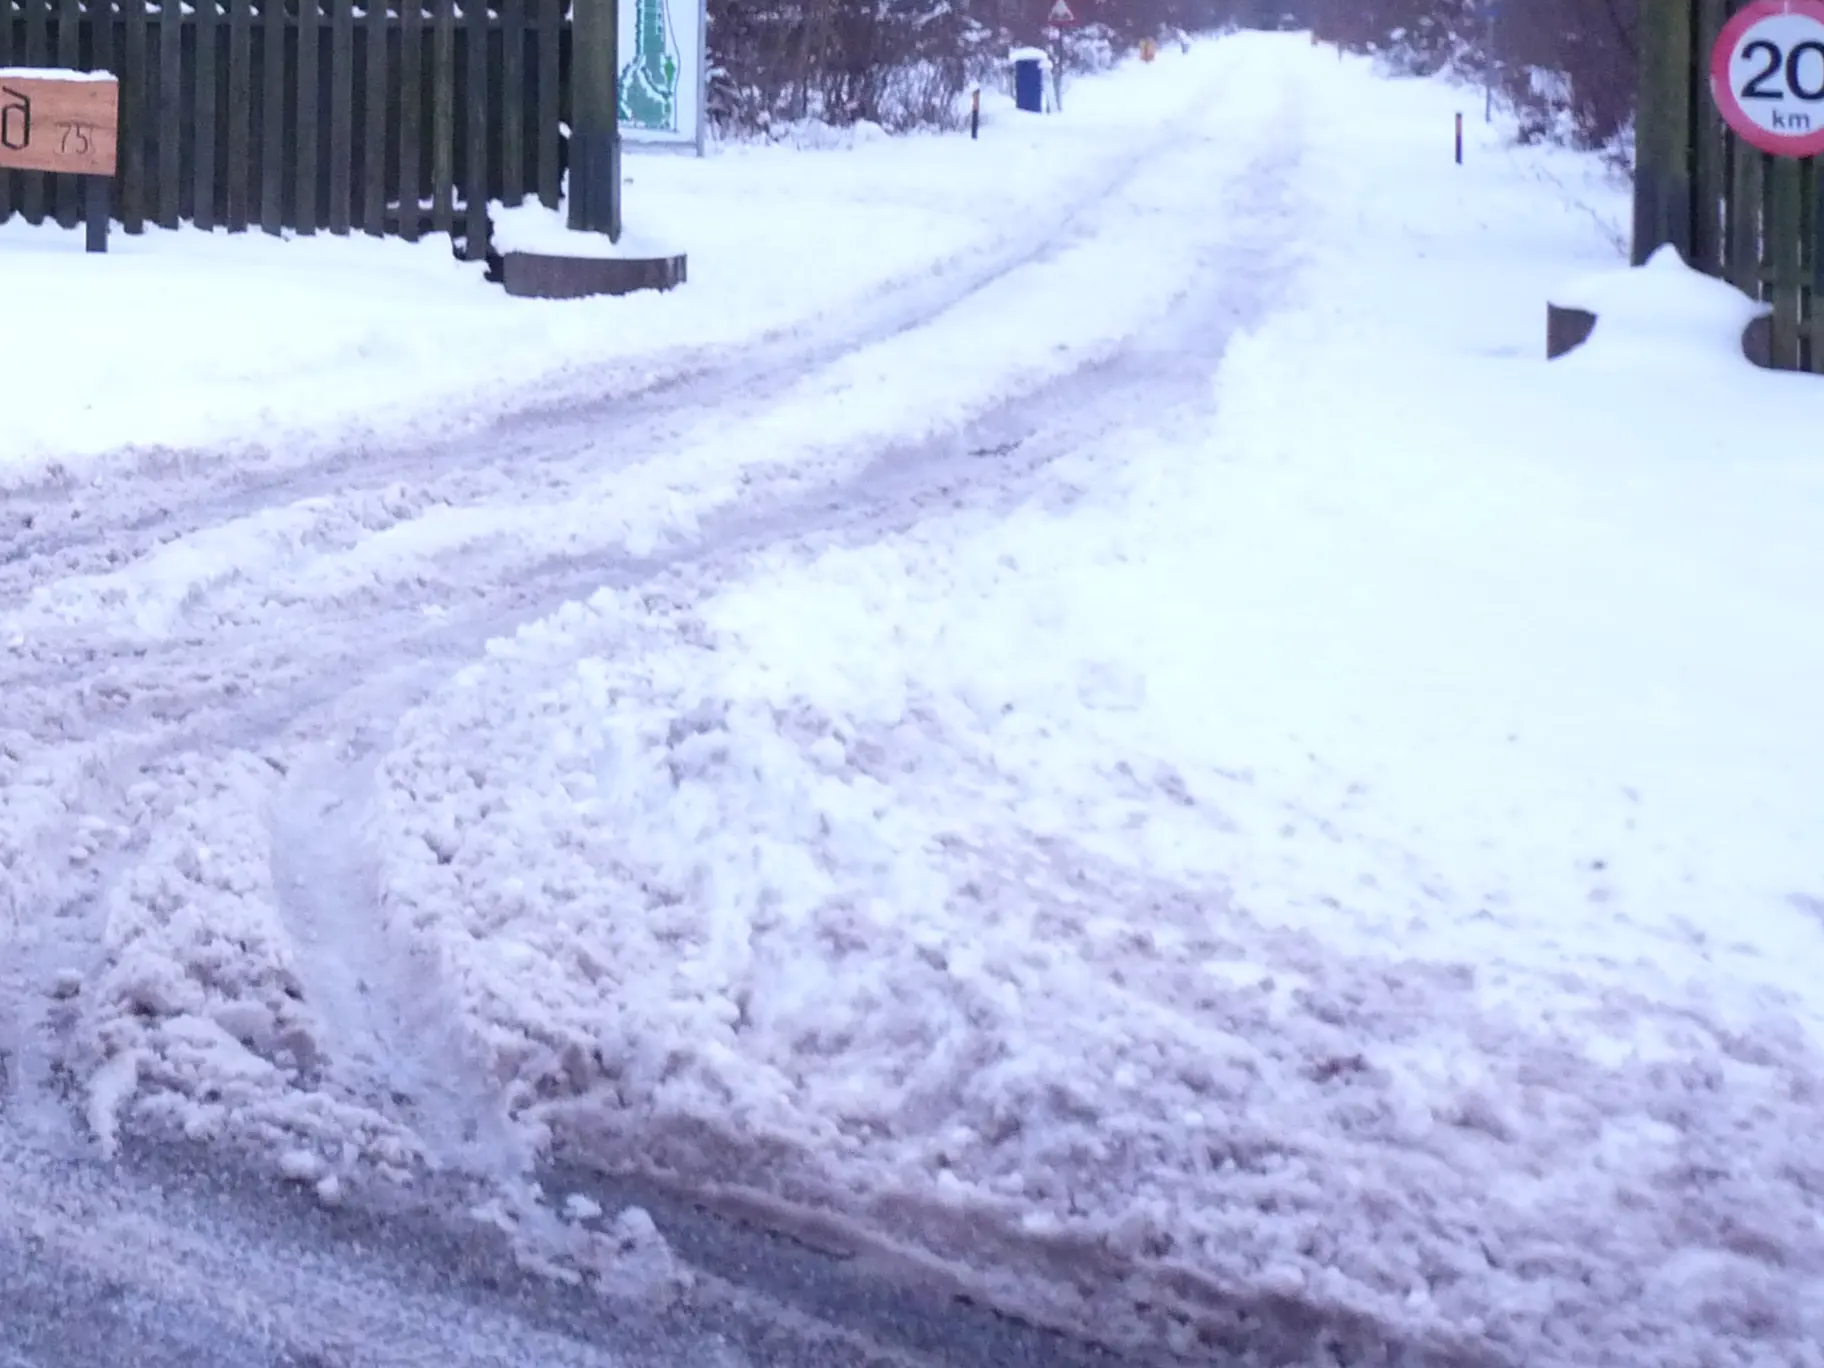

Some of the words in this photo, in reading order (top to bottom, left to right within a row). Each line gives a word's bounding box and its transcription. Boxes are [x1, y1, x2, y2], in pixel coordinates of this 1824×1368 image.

[1740, 40, 1824, 101] 20
[1772, 109, 1810, 129] km
[55, 121, 89, 154] 75
